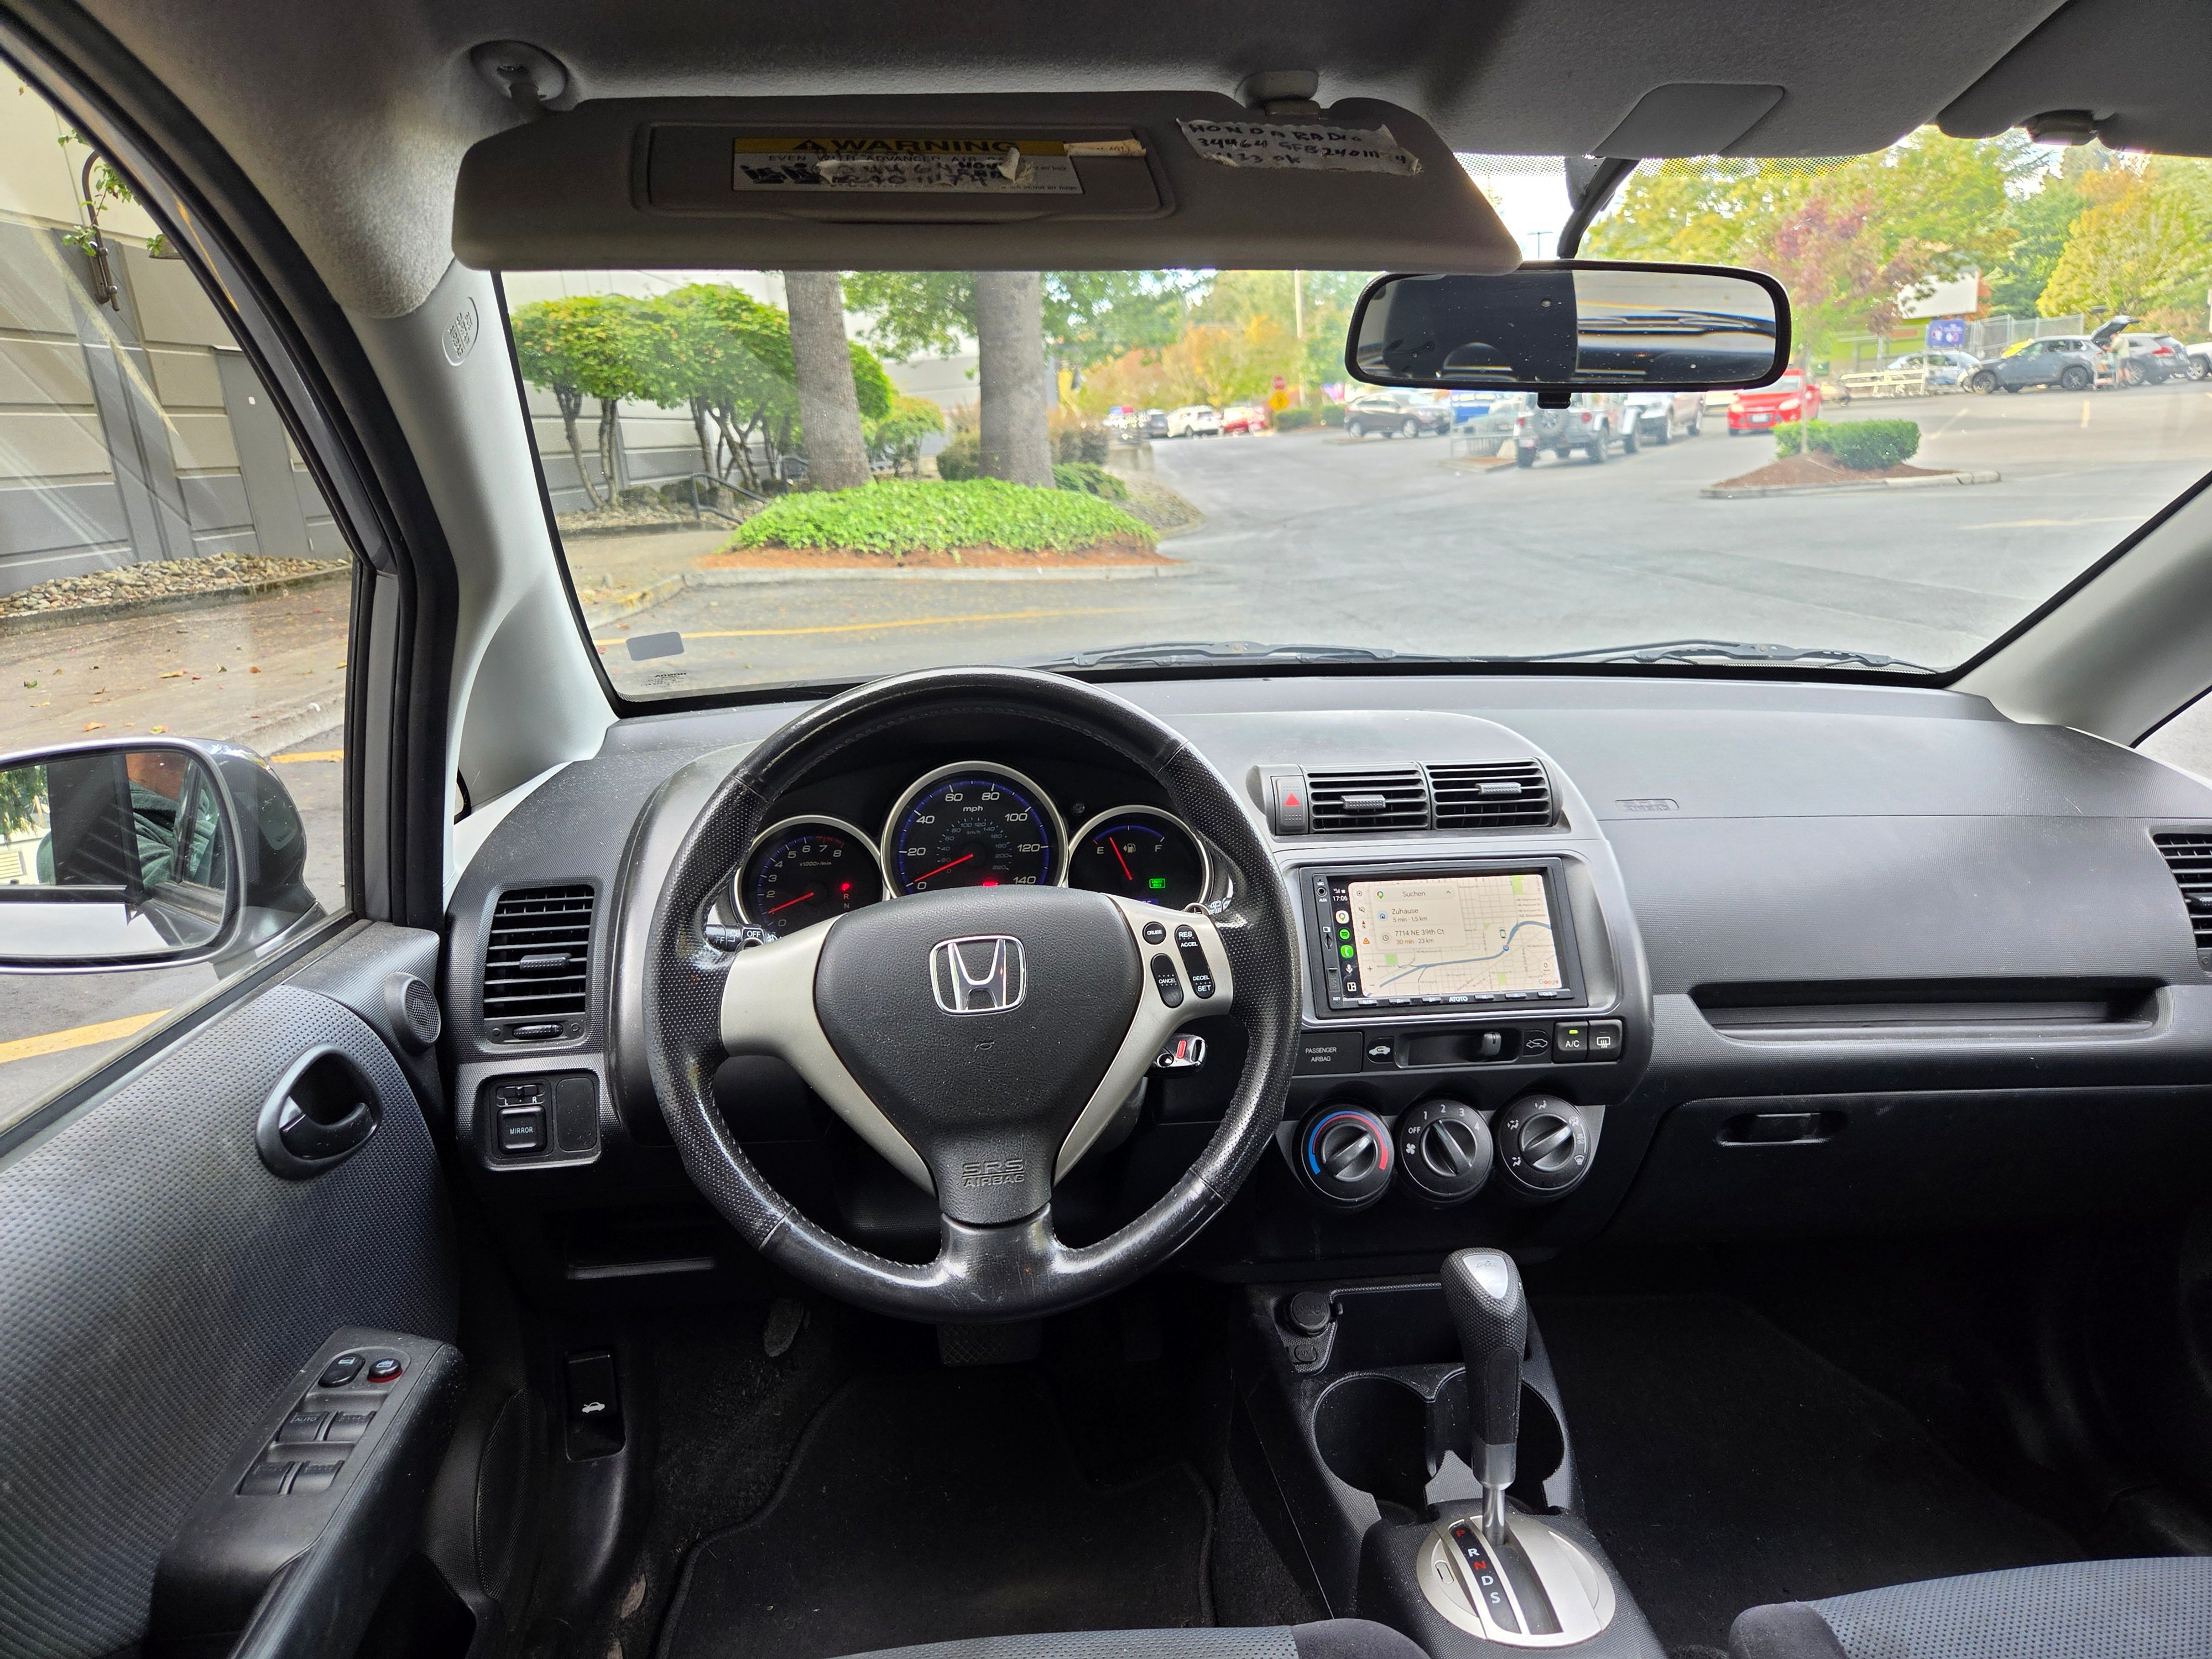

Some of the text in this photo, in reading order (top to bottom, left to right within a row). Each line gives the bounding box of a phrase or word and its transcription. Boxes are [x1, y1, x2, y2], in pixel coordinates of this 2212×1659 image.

[831, 139, 1019, 152] WARNING
[448, 325, 463, 357] AIRBAG
[945, 793, 963, 802] 60
[981, 792, 1000, 801] 80
[916, 815, 935, 824] 40
[1004, 812, 1028, 822] 100
[907, 847, 926, 856] 20
[1017, 843, 1040, 852] 120
[787, 851, 797, 859] 5
[1013, 876, 1036, 884] 140
[917, 881, 927, 890] 0
[766, 890, 775, 898] 2
[778, 919, 787, 927] 0
[1440, 1104, 1446, 1113] 2
[1459, 1108, 1465, 1117] 3
[1423, 1111, 1427, 1120] 1
[509, 1126, 534, 1135] MIRROR
[1474, 1122, 1480, 1131] 4
[962, 1159, 1023, 1176] SRS
[963, 1172, 1024, 1188] AIRBAG
[1468, 1548, 1480, 1557] R
[1474, 1560, 1486, 1571] N
[1481, 1575, 1494, 1586] D
[1490, 1592, 1500, 1604] S
